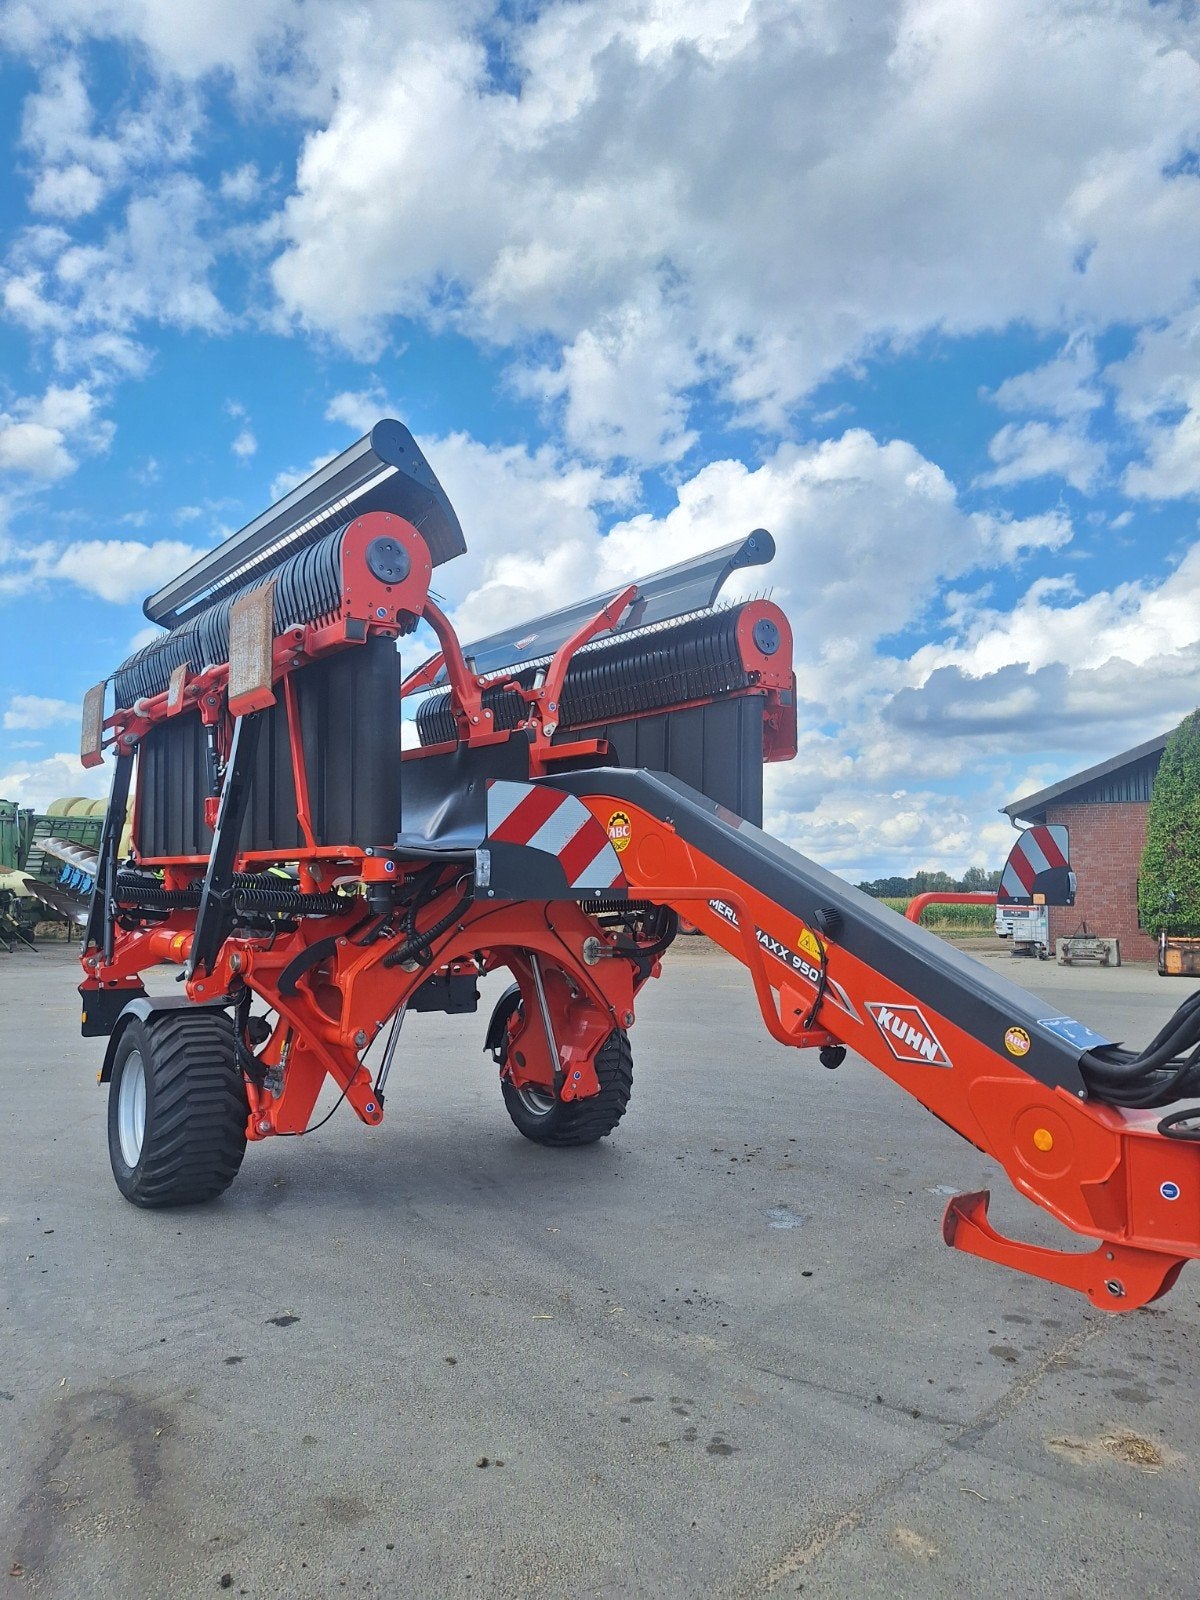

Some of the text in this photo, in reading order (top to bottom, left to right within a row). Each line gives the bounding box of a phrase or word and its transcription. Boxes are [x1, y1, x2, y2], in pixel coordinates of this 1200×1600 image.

[609, 825, 630, 838] ABC
[792, 955, 819, 982] 950
[877, 1006, 939, 1062] KUHN
